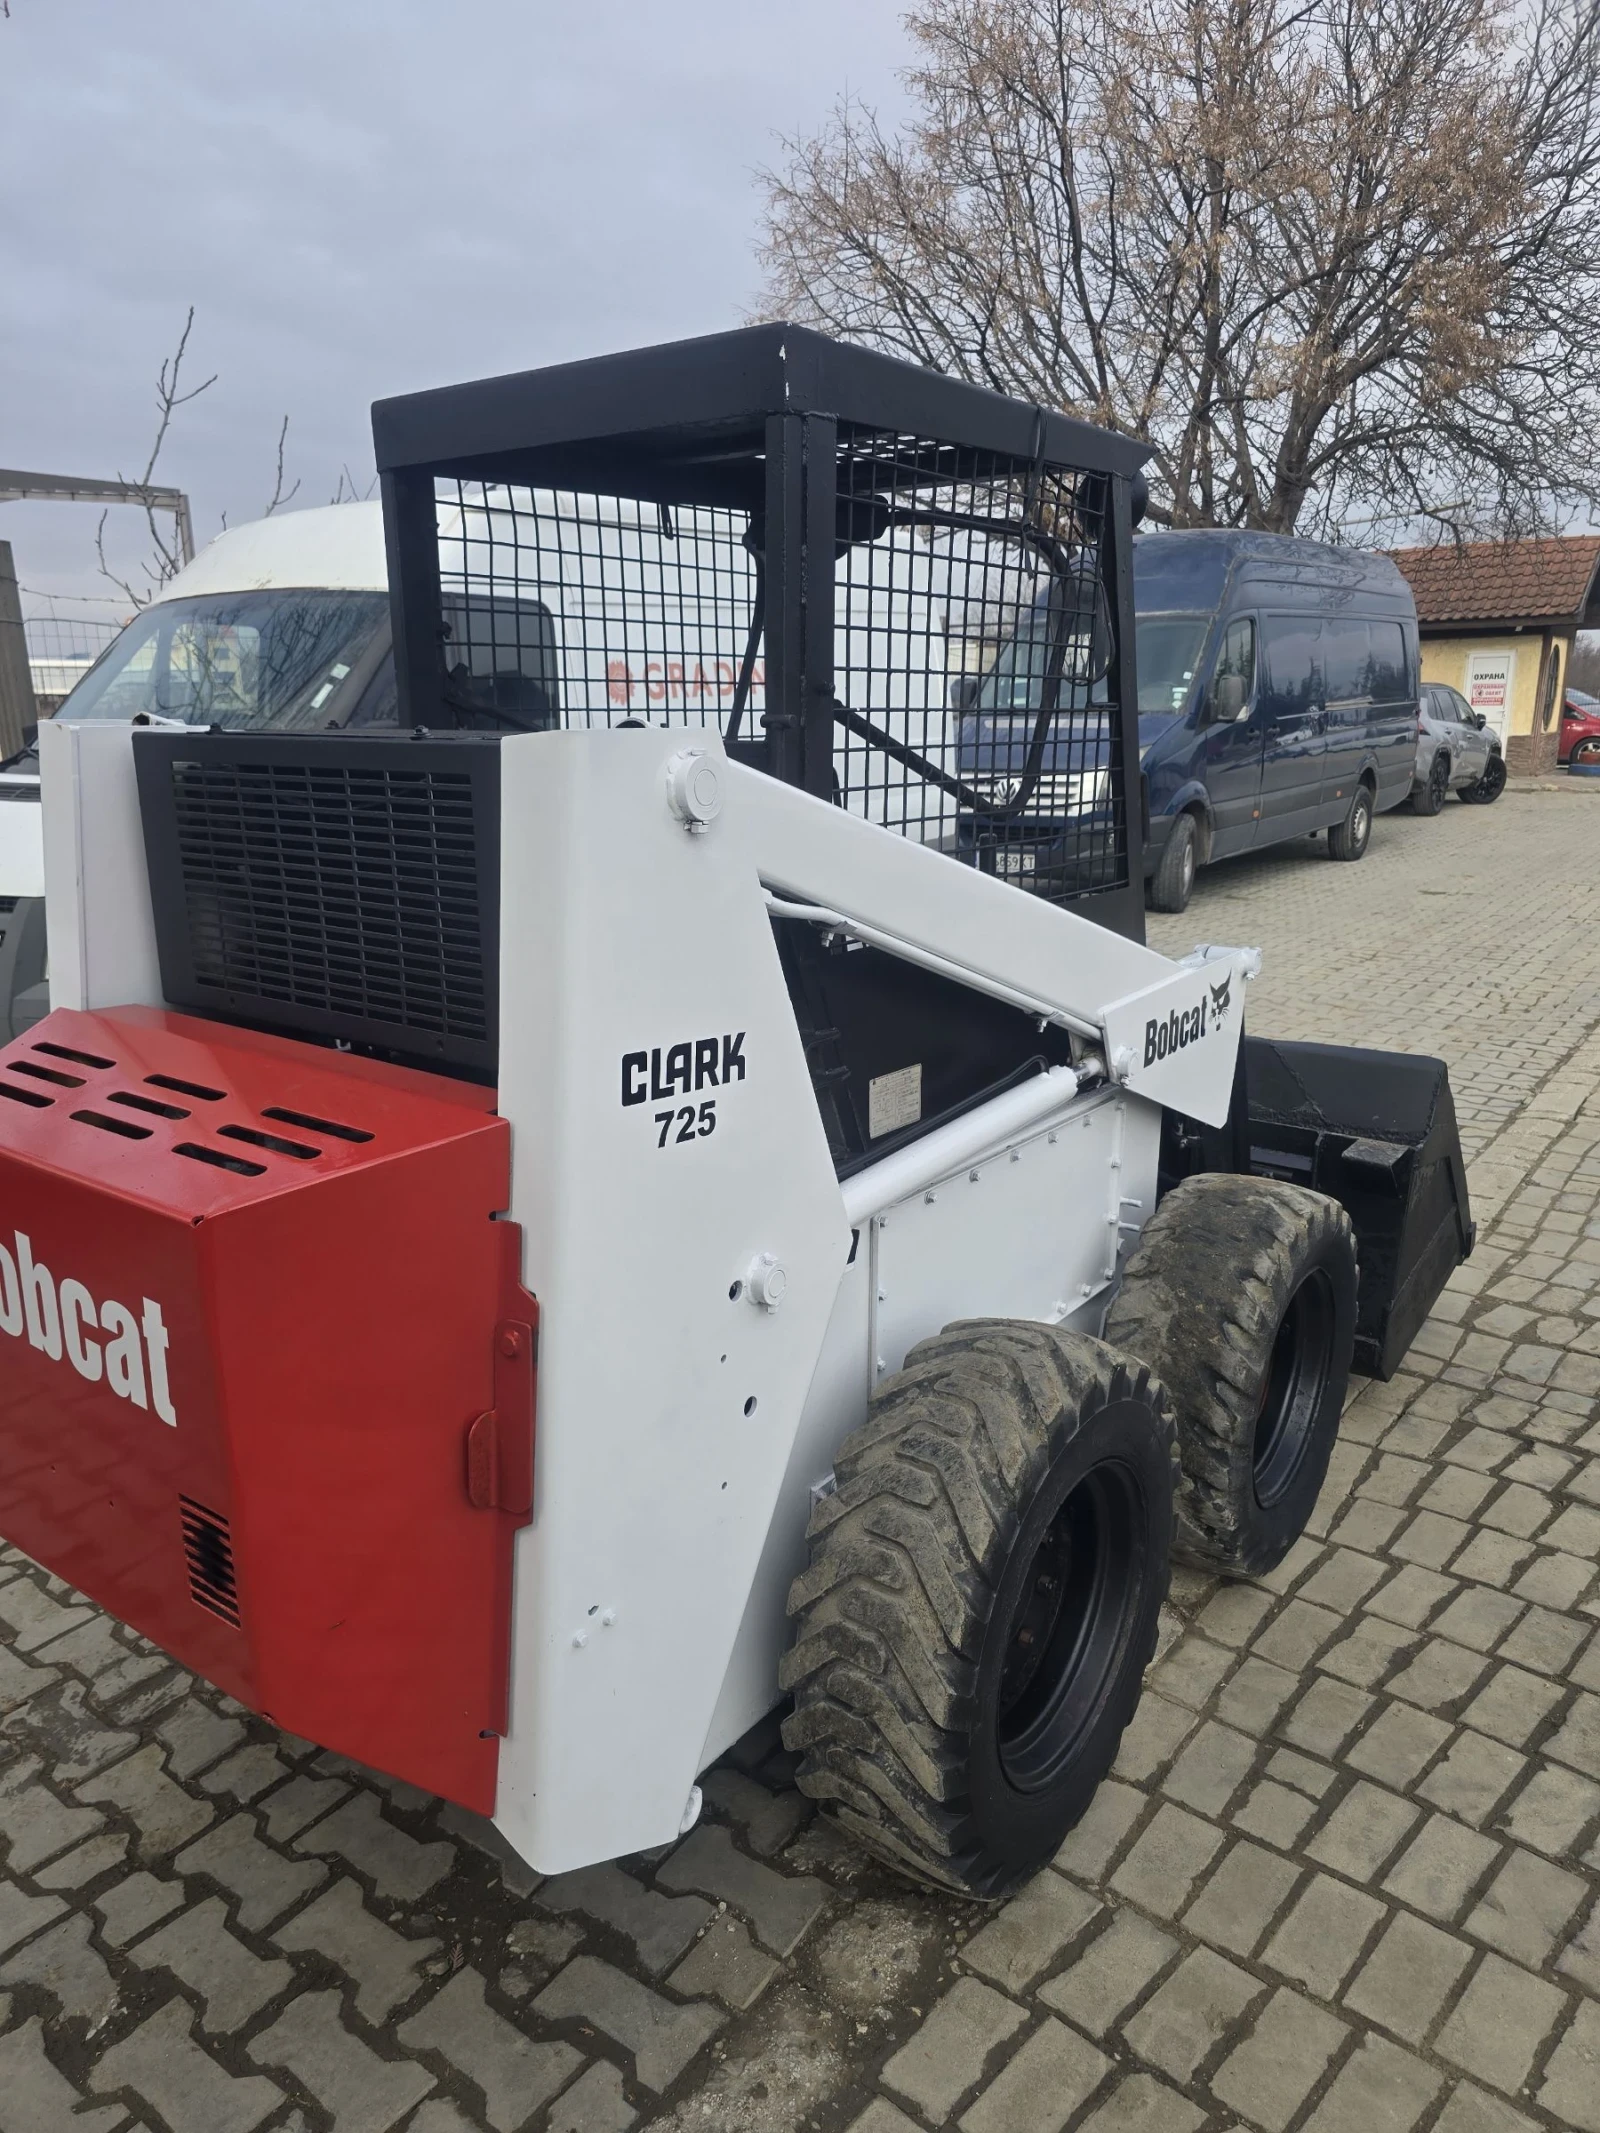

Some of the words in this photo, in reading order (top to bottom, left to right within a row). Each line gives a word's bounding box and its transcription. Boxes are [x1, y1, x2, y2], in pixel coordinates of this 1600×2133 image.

[621, 1031, 746, 1107] CLARK
[1143, 995, 1208, 1069] Bobcat
[654, 1099, 717, 1149] 725
